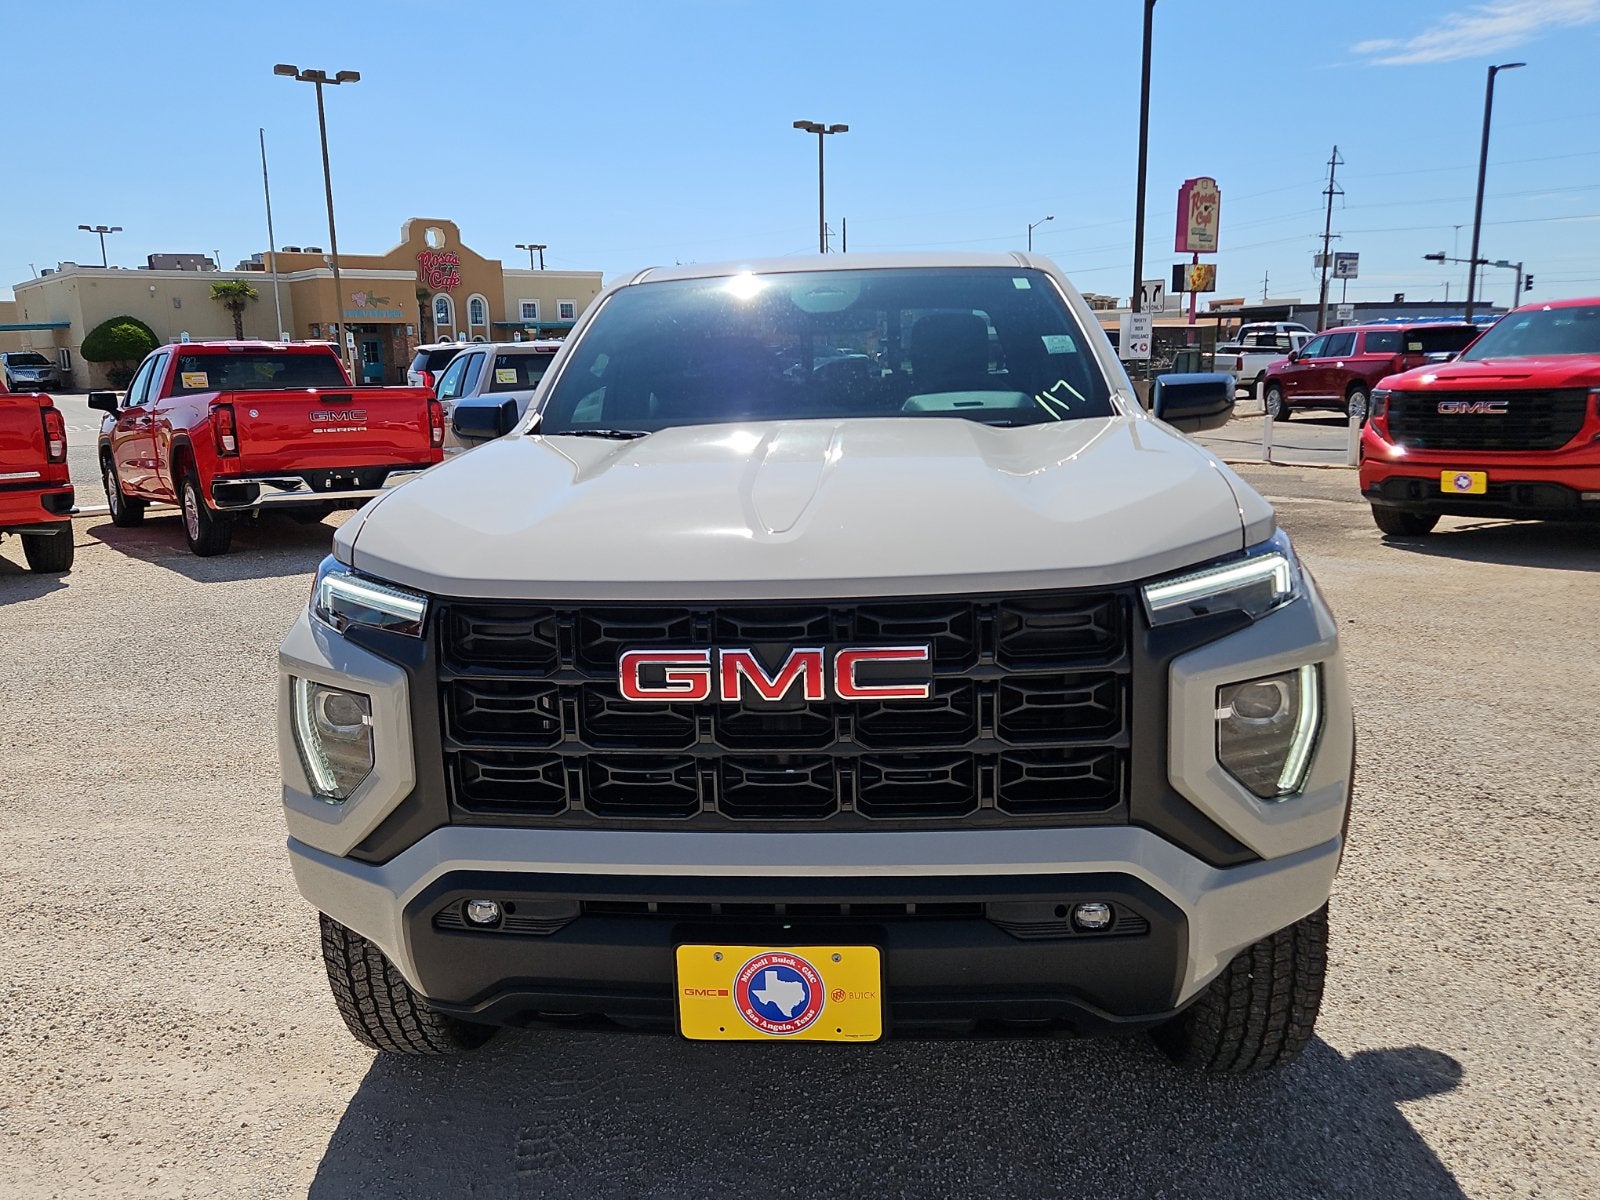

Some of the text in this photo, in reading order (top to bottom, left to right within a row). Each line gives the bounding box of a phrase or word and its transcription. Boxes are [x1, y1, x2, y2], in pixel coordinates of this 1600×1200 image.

[417, 250, 460, 282] Rosa's
[1437, 401, 1509, 414] GMC
[309, 409, 368, 422] GMC
[312, 426, 368, 434] SIERRA
[618, 646, 930, 702] GMC
[741, 958, 768, 983] Mitchell
[771, 956, 796, 967] Buick
[801, 966, 817, 984] GMC
[684, 988, 717, 997] GMC
[849, 991, 876, 1000] BUICK
[745, 1008, 815, 1032] San Angelo, Texas
